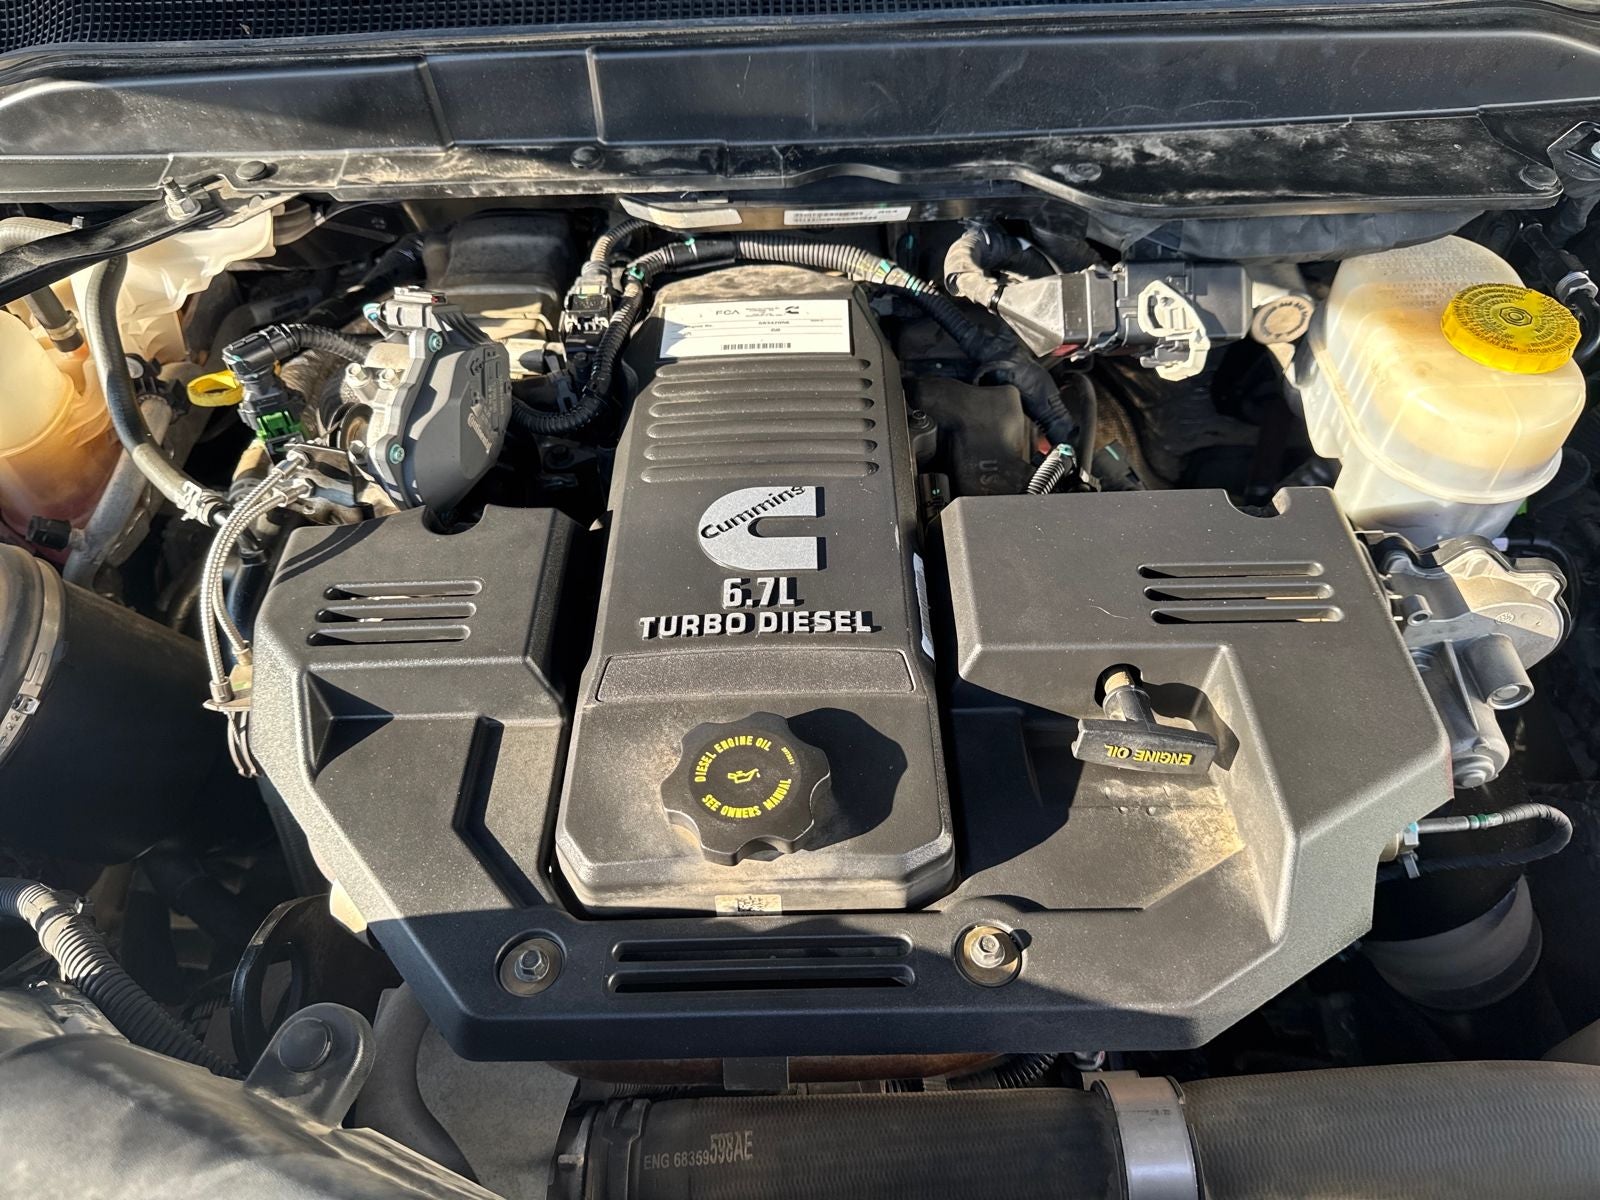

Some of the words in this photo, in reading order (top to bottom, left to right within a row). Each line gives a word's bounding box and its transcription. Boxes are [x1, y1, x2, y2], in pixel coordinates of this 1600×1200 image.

[700, 485, 806, 539] Cummins
[723, 576, 796, 609] 6.7L
[639, 612, 748, 640] TURBO
[757, 610, 872, 636] DIESEL
[694, 751, 717, 782] DIESEL
[714, 735, 754, 753] ENGINE
[755, 737, 772, 751] OIL
[1103, 743, 1131, 759] OIL
[1132, 748, 1194, 766] ENGINE
[702, 794, 722, 811] SEE
[720, 805, 762, 818] OWNERS
[762, 778, 792, 811] MANUAL
[643, 1152, 670, 1170] ENG
